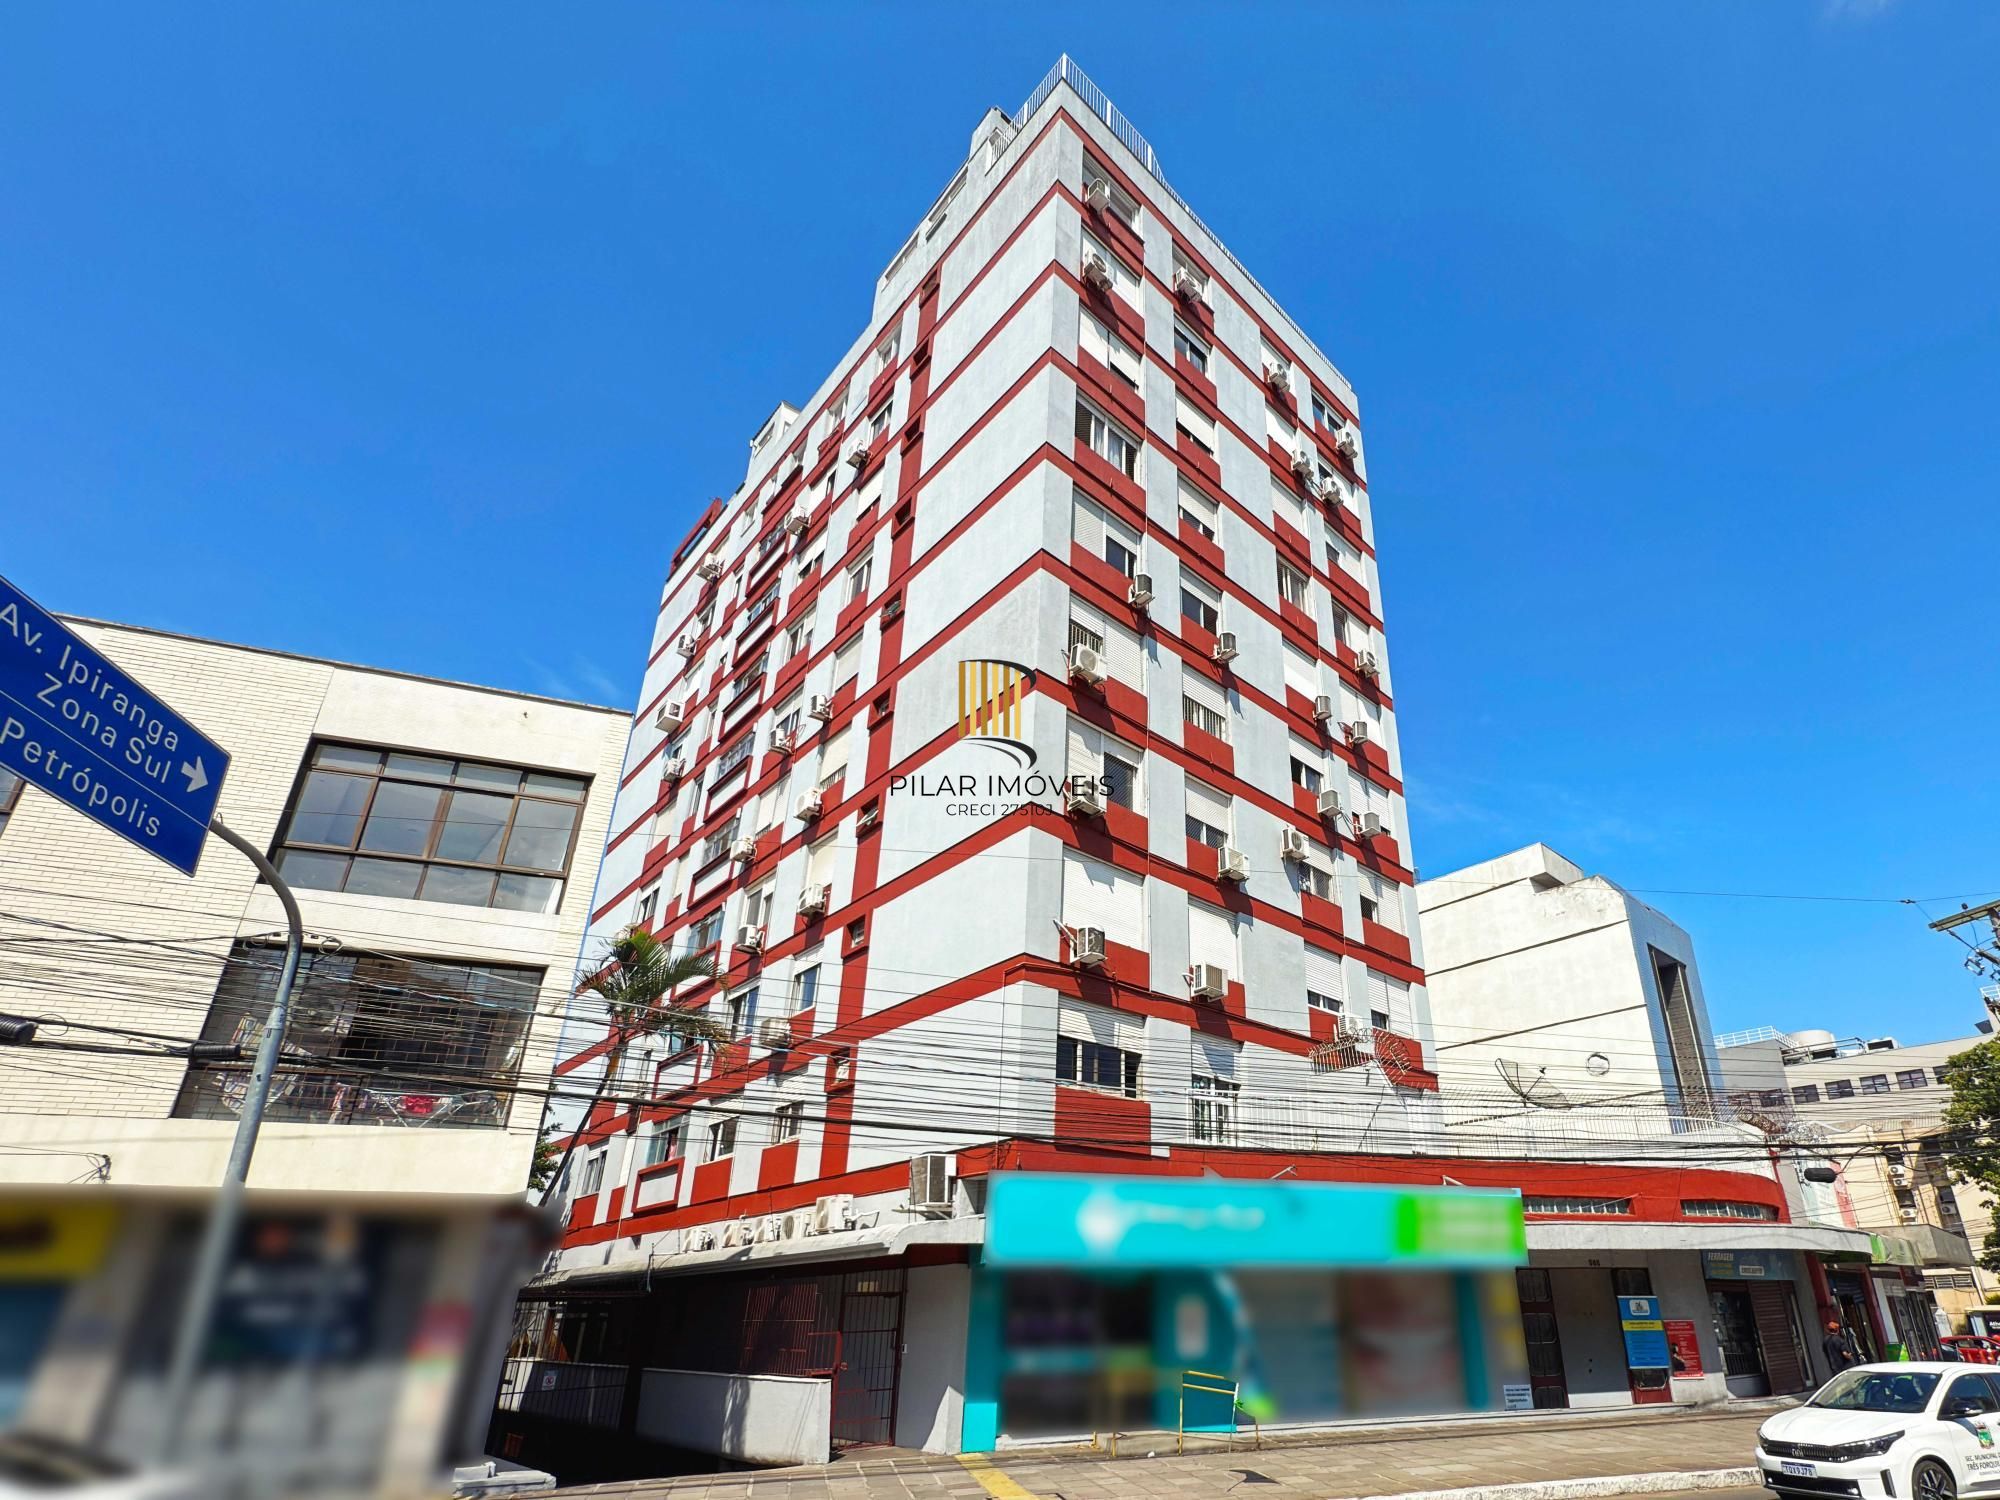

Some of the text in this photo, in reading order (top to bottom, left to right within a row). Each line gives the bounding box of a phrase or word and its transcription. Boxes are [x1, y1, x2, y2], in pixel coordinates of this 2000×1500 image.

[0, 603, 179, 752] Av. Ipiranga
[37, 672, 172, 784] Zona Sul
[0, 717, 161, 837] Petrópolis
